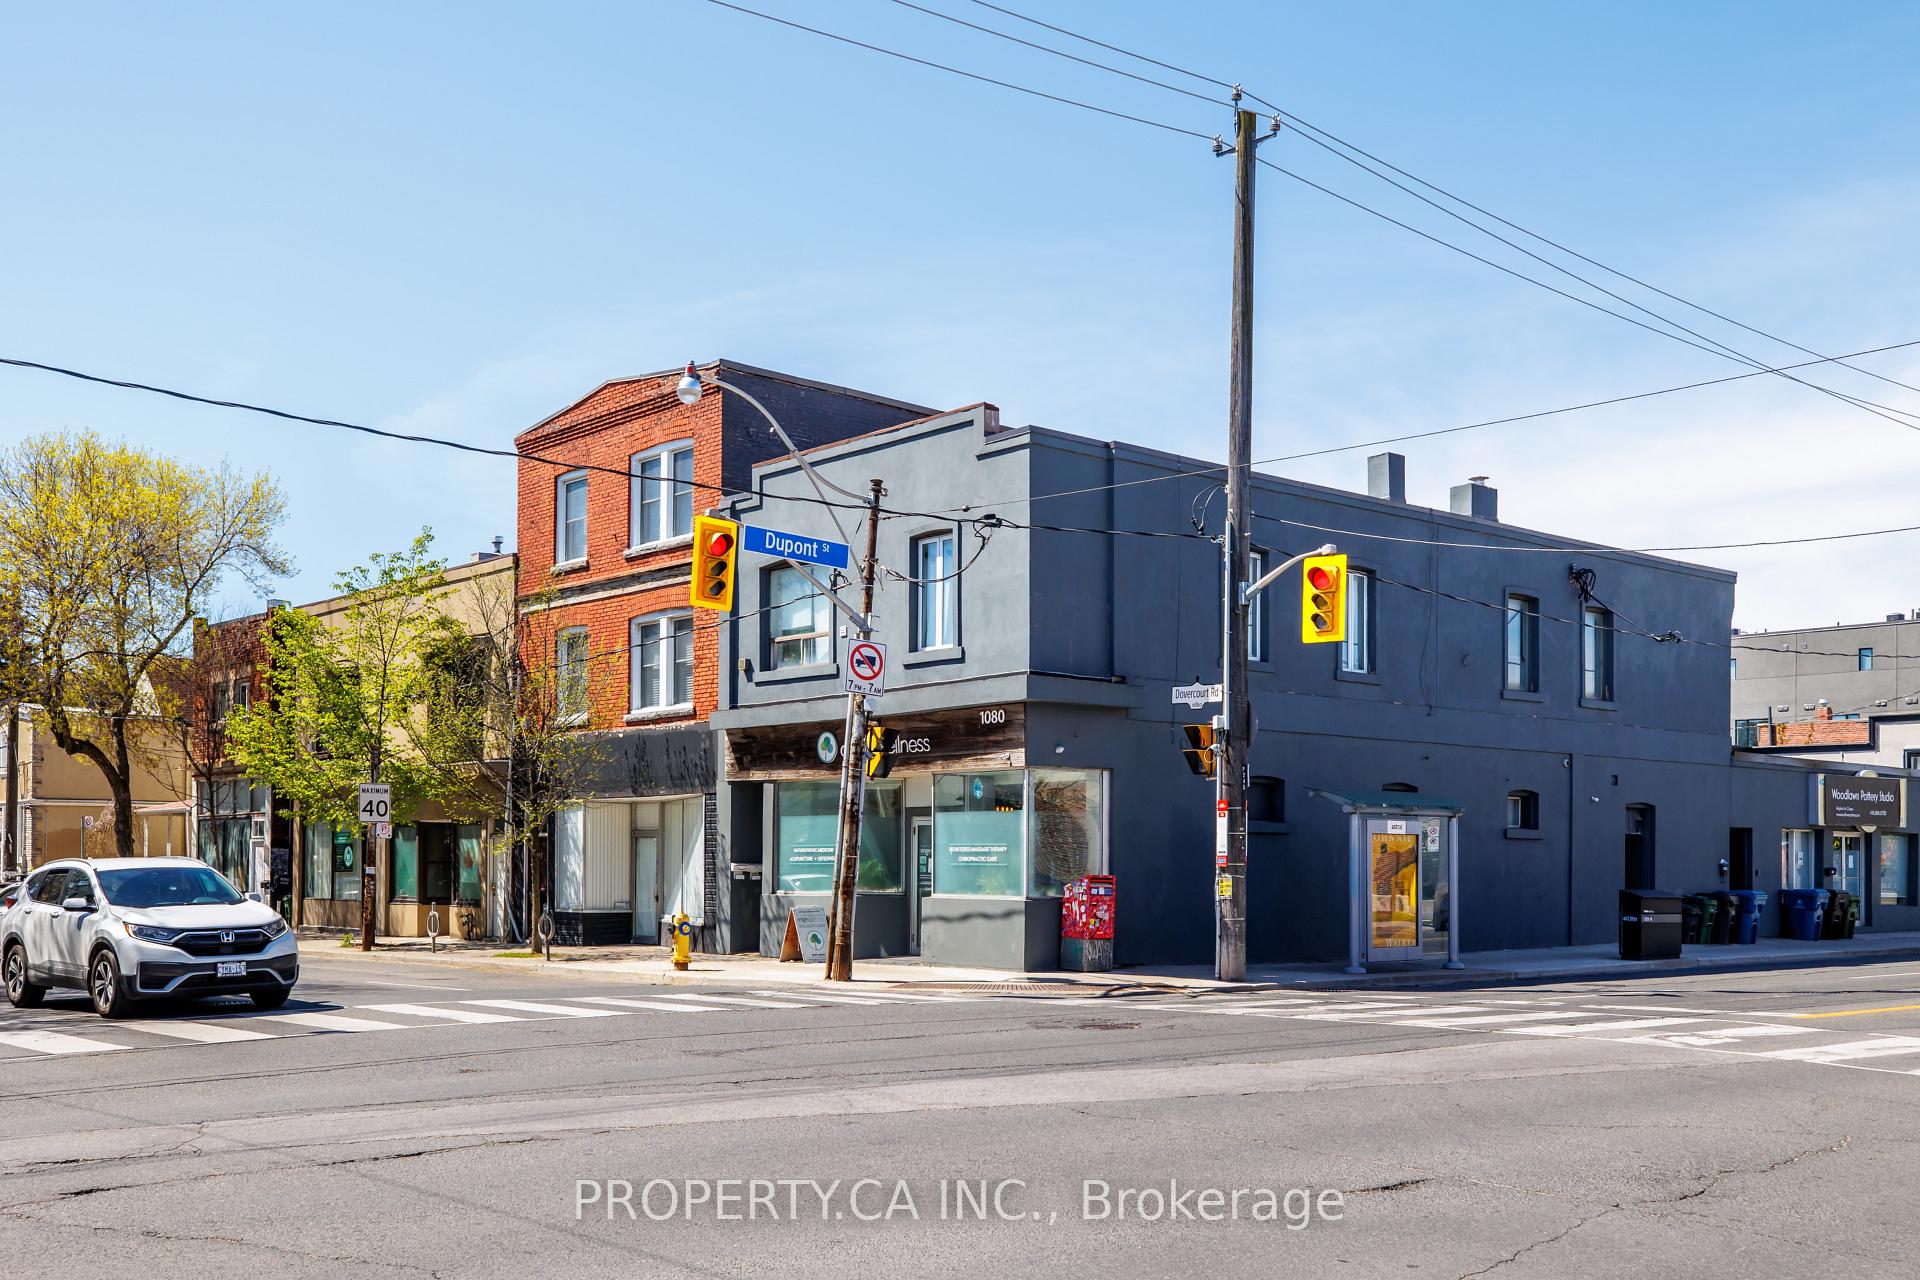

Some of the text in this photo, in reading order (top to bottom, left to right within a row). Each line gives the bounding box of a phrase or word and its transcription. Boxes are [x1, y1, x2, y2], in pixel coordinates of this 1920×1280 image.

[765, 531, 830, 558] Dupont St
[848, 680, 853, 690] 7
[868, 682, 873, 692] 7
[1175, 687, 1219, 699] Dovercourt Rd
[979, 709, 1005, 725] 1080
[888, 734, 931, 754] llness
[1831, 788, 1895, 804] Woodlawn Pottery Studio
[361, 799, 388, 817] 40
